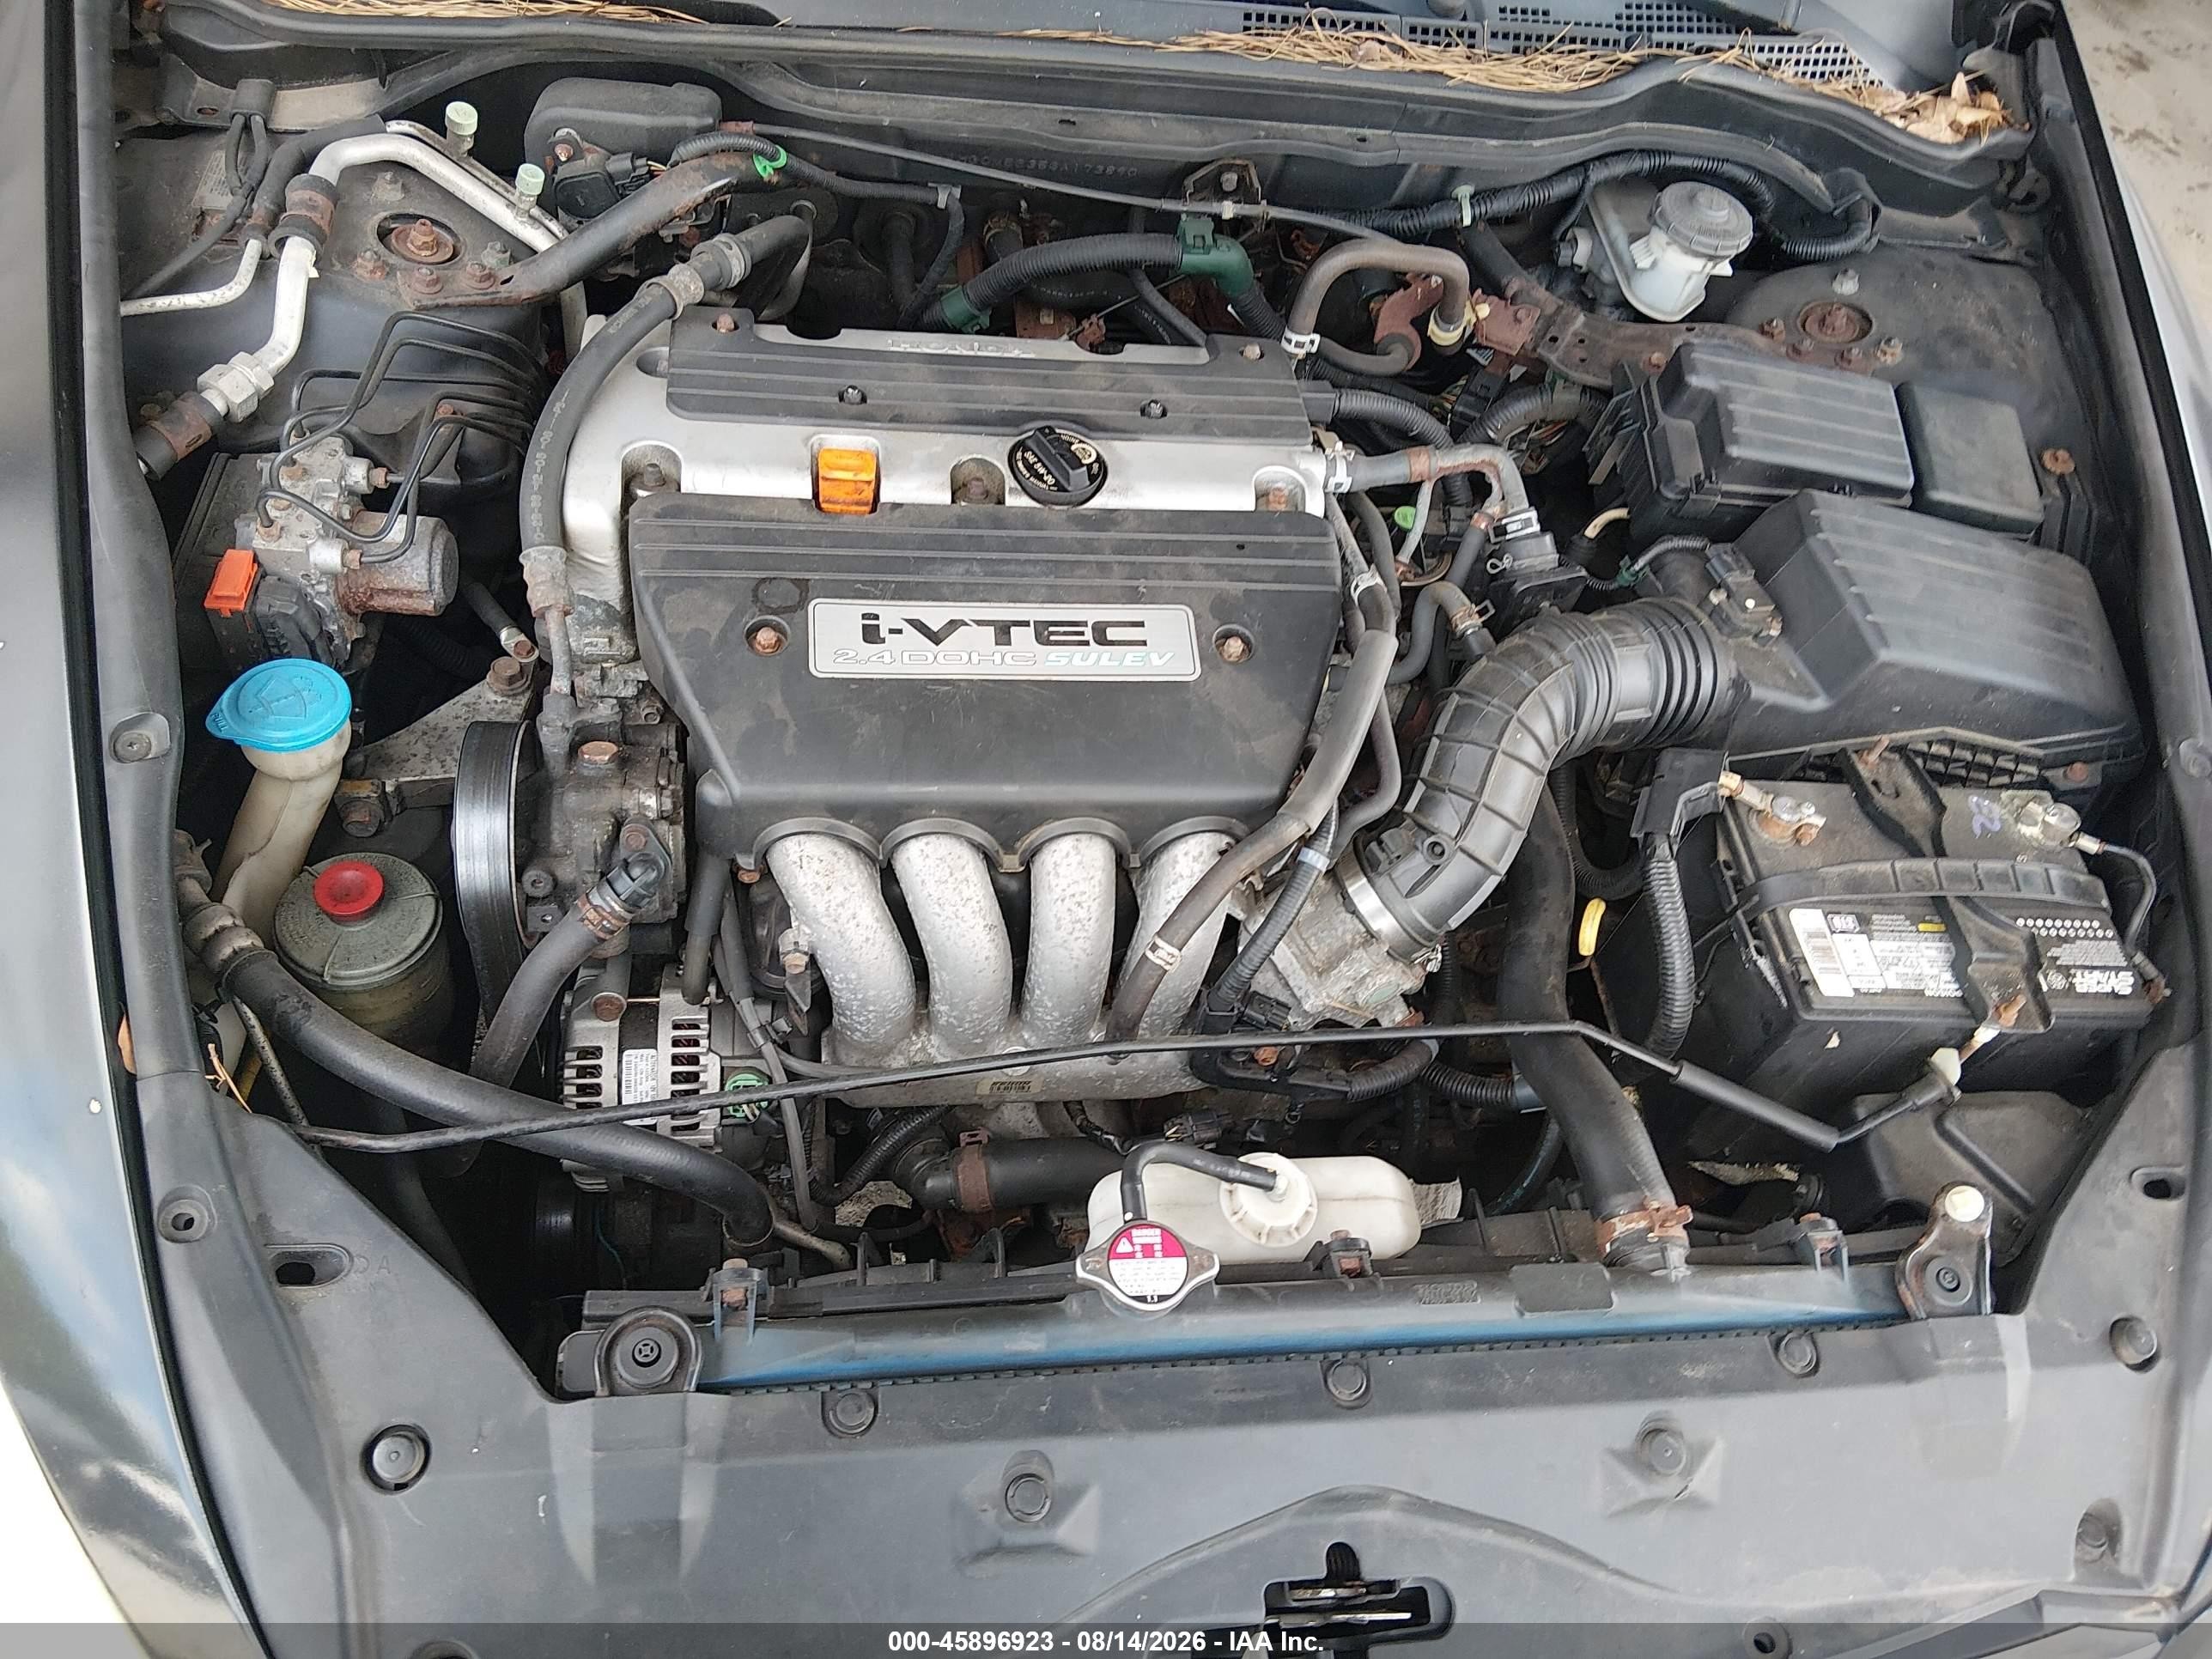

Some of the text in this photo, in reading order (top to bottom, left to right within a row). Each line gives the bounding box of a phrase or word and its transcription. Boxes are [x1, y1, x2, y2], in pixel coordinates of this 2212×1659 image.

[861, 612, 1148, 647] i-VTEC
[832, 648, 1176, 667] 2.4 DOHC SULEV
